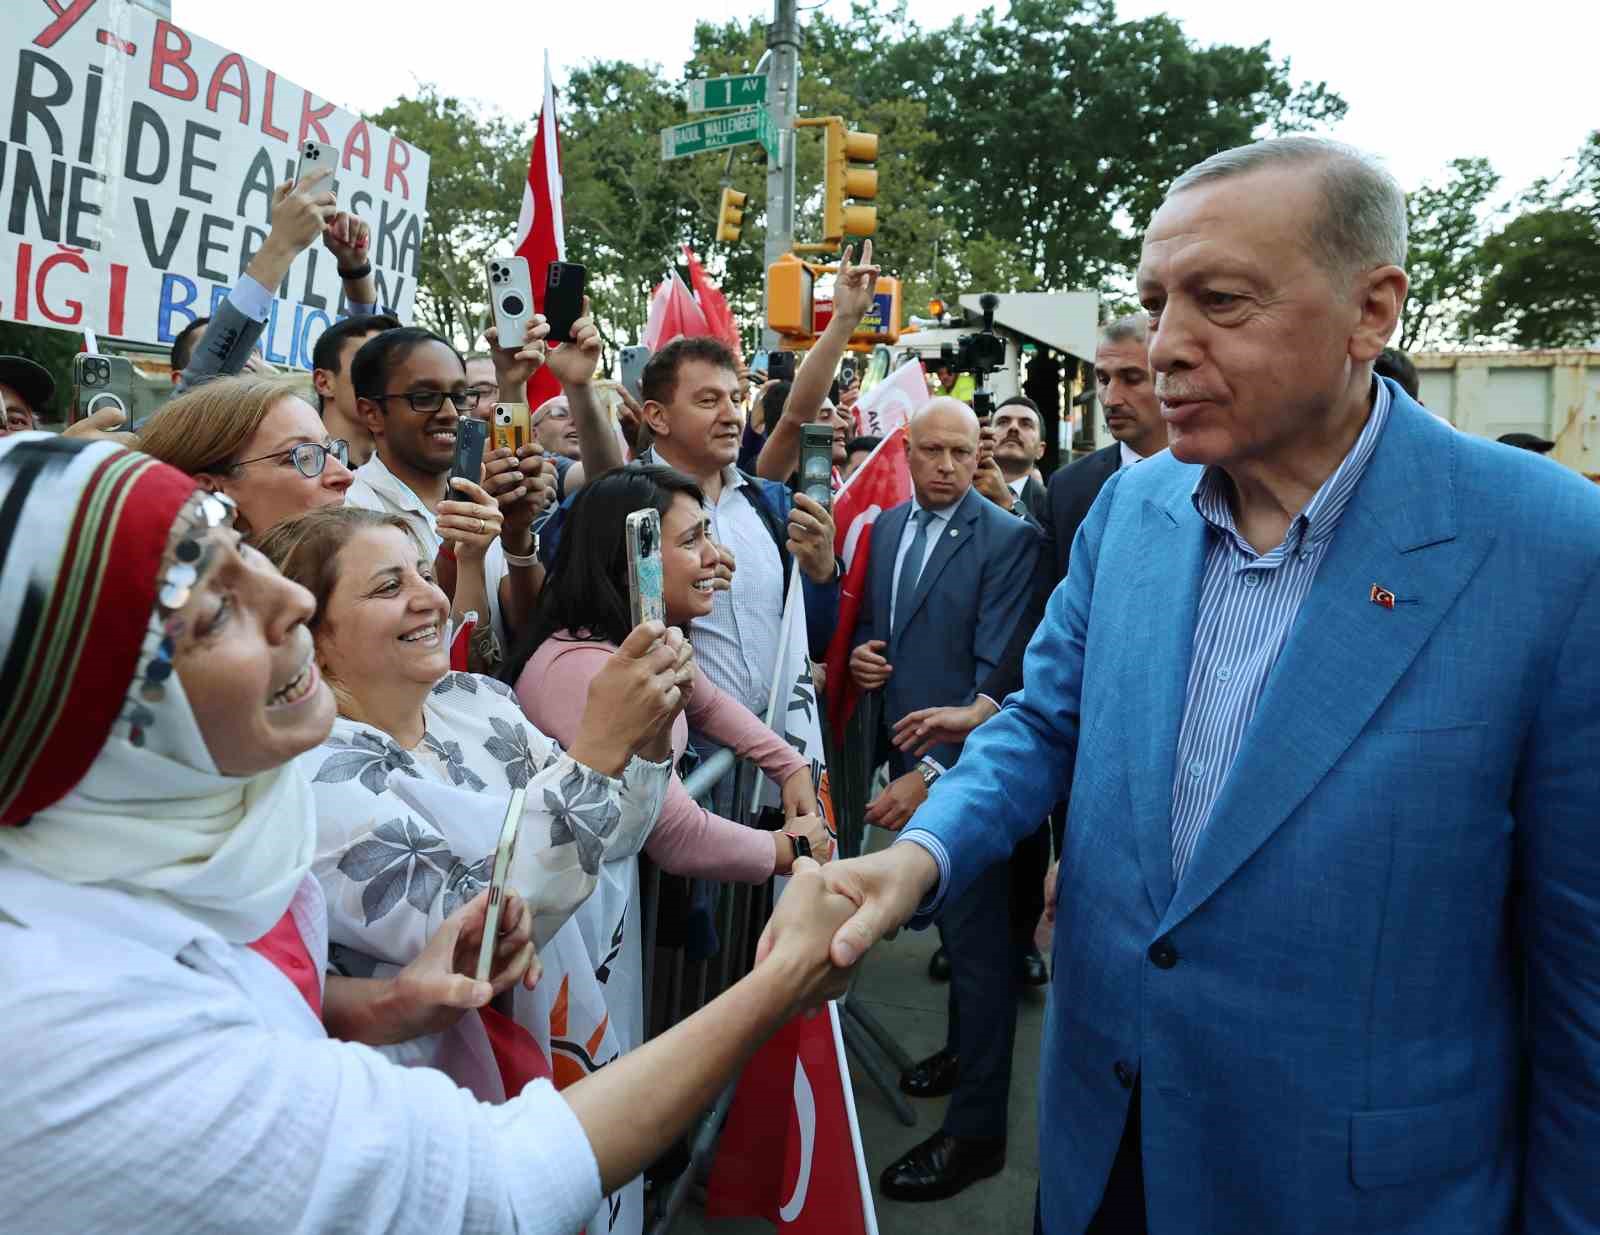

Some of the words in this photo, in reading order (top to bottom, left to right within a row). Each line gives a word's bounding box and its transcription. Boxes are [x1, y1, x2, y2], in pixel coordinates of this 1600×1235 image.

[725, 81, 732, 104] 1
[742, 79, 759, 91] AV
[0, 243, 129, 337] IĞI
